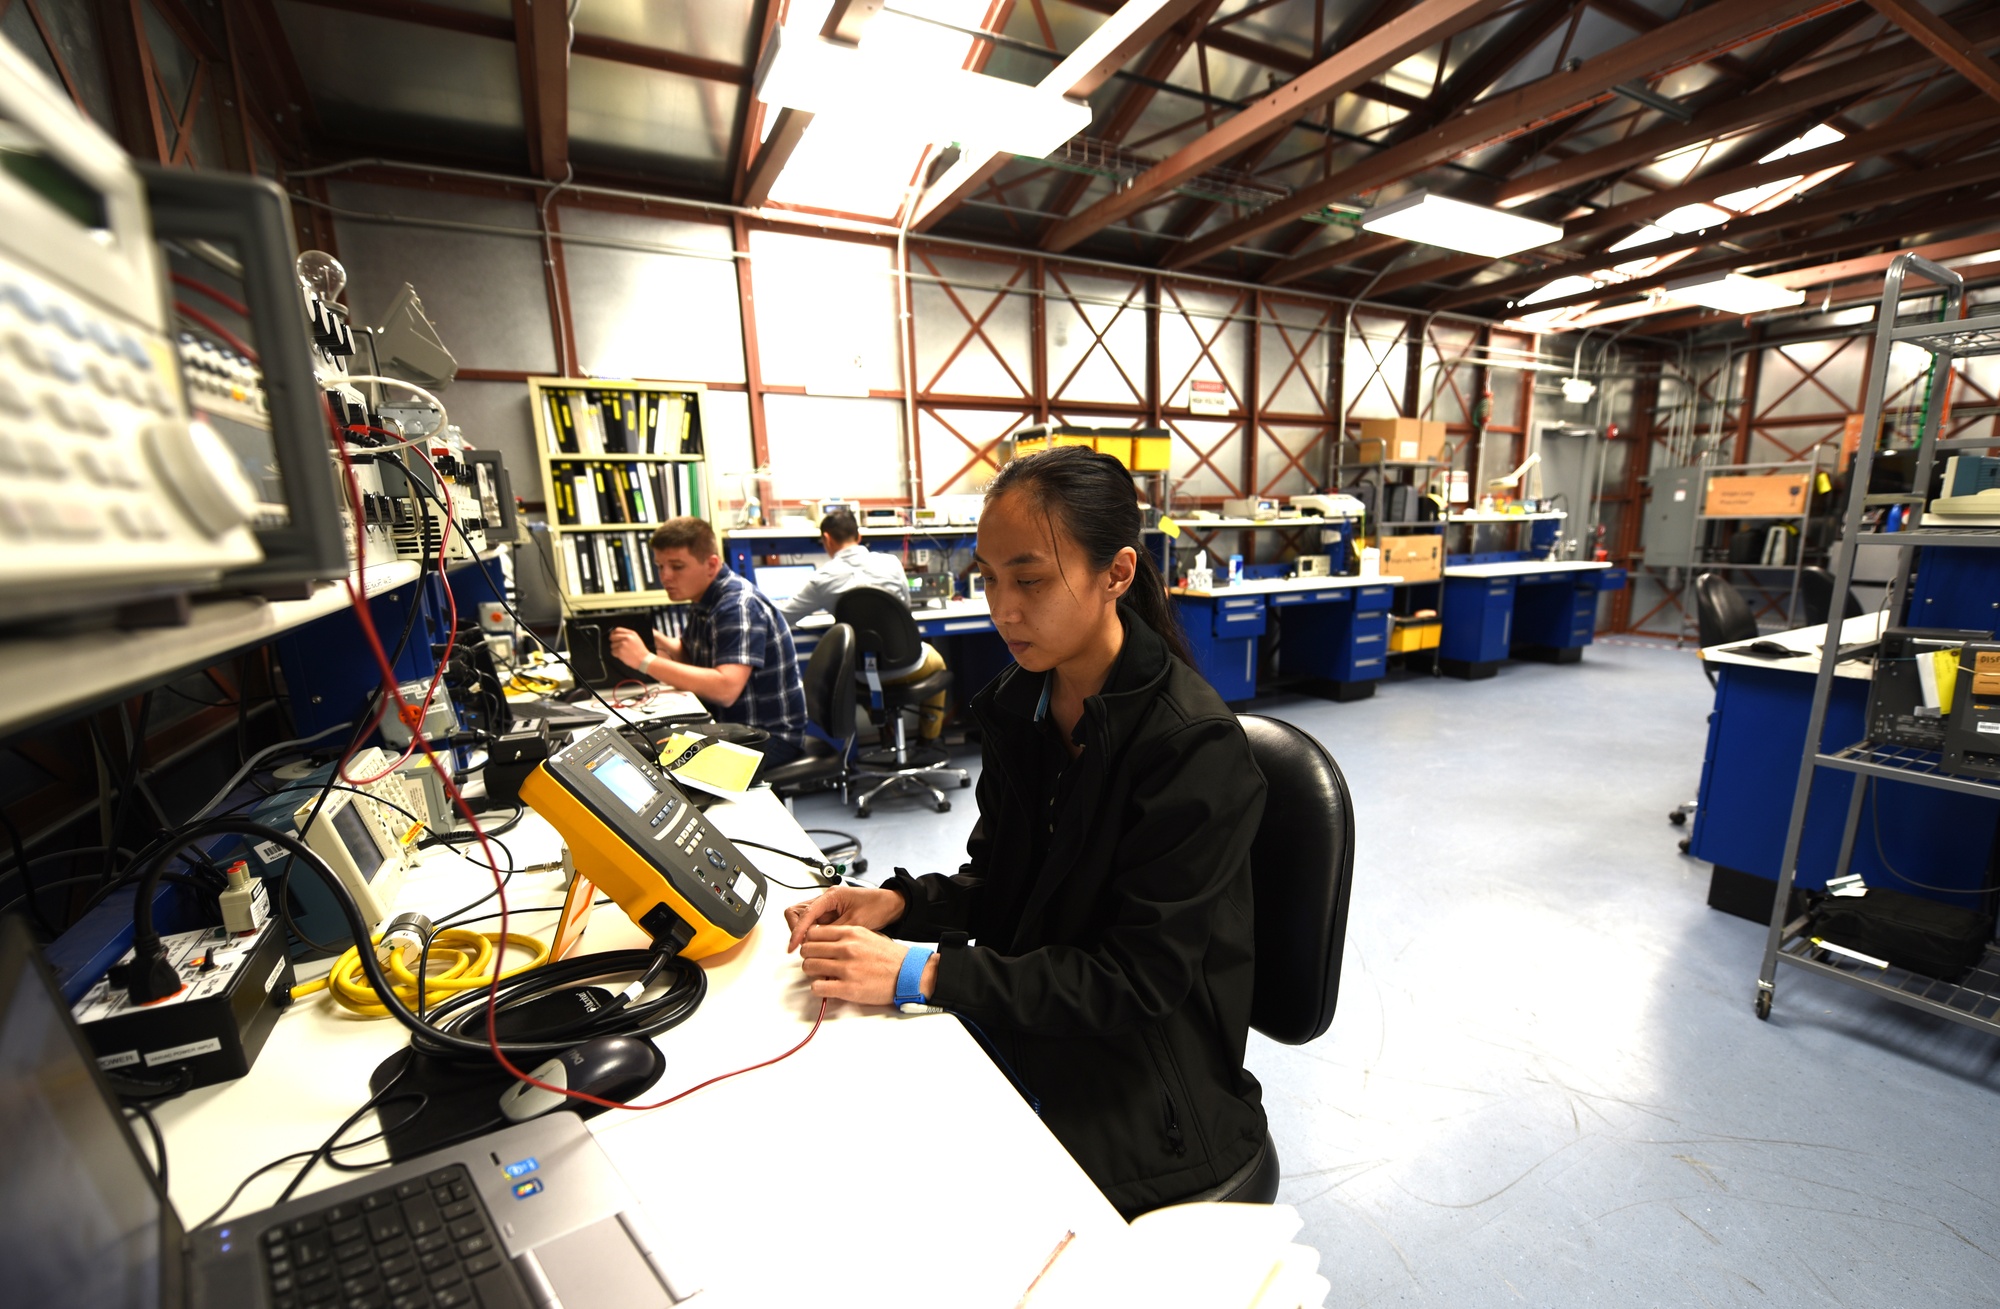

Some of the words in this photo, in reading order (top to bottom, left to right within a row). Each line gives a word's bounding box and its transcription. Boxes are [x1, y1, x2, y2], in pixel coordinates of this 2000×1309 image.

[674, 744, 700, 768] COM
[173, 1047, 196, 1057] POWER
[196, 1043, 215, 1051] INPUT
